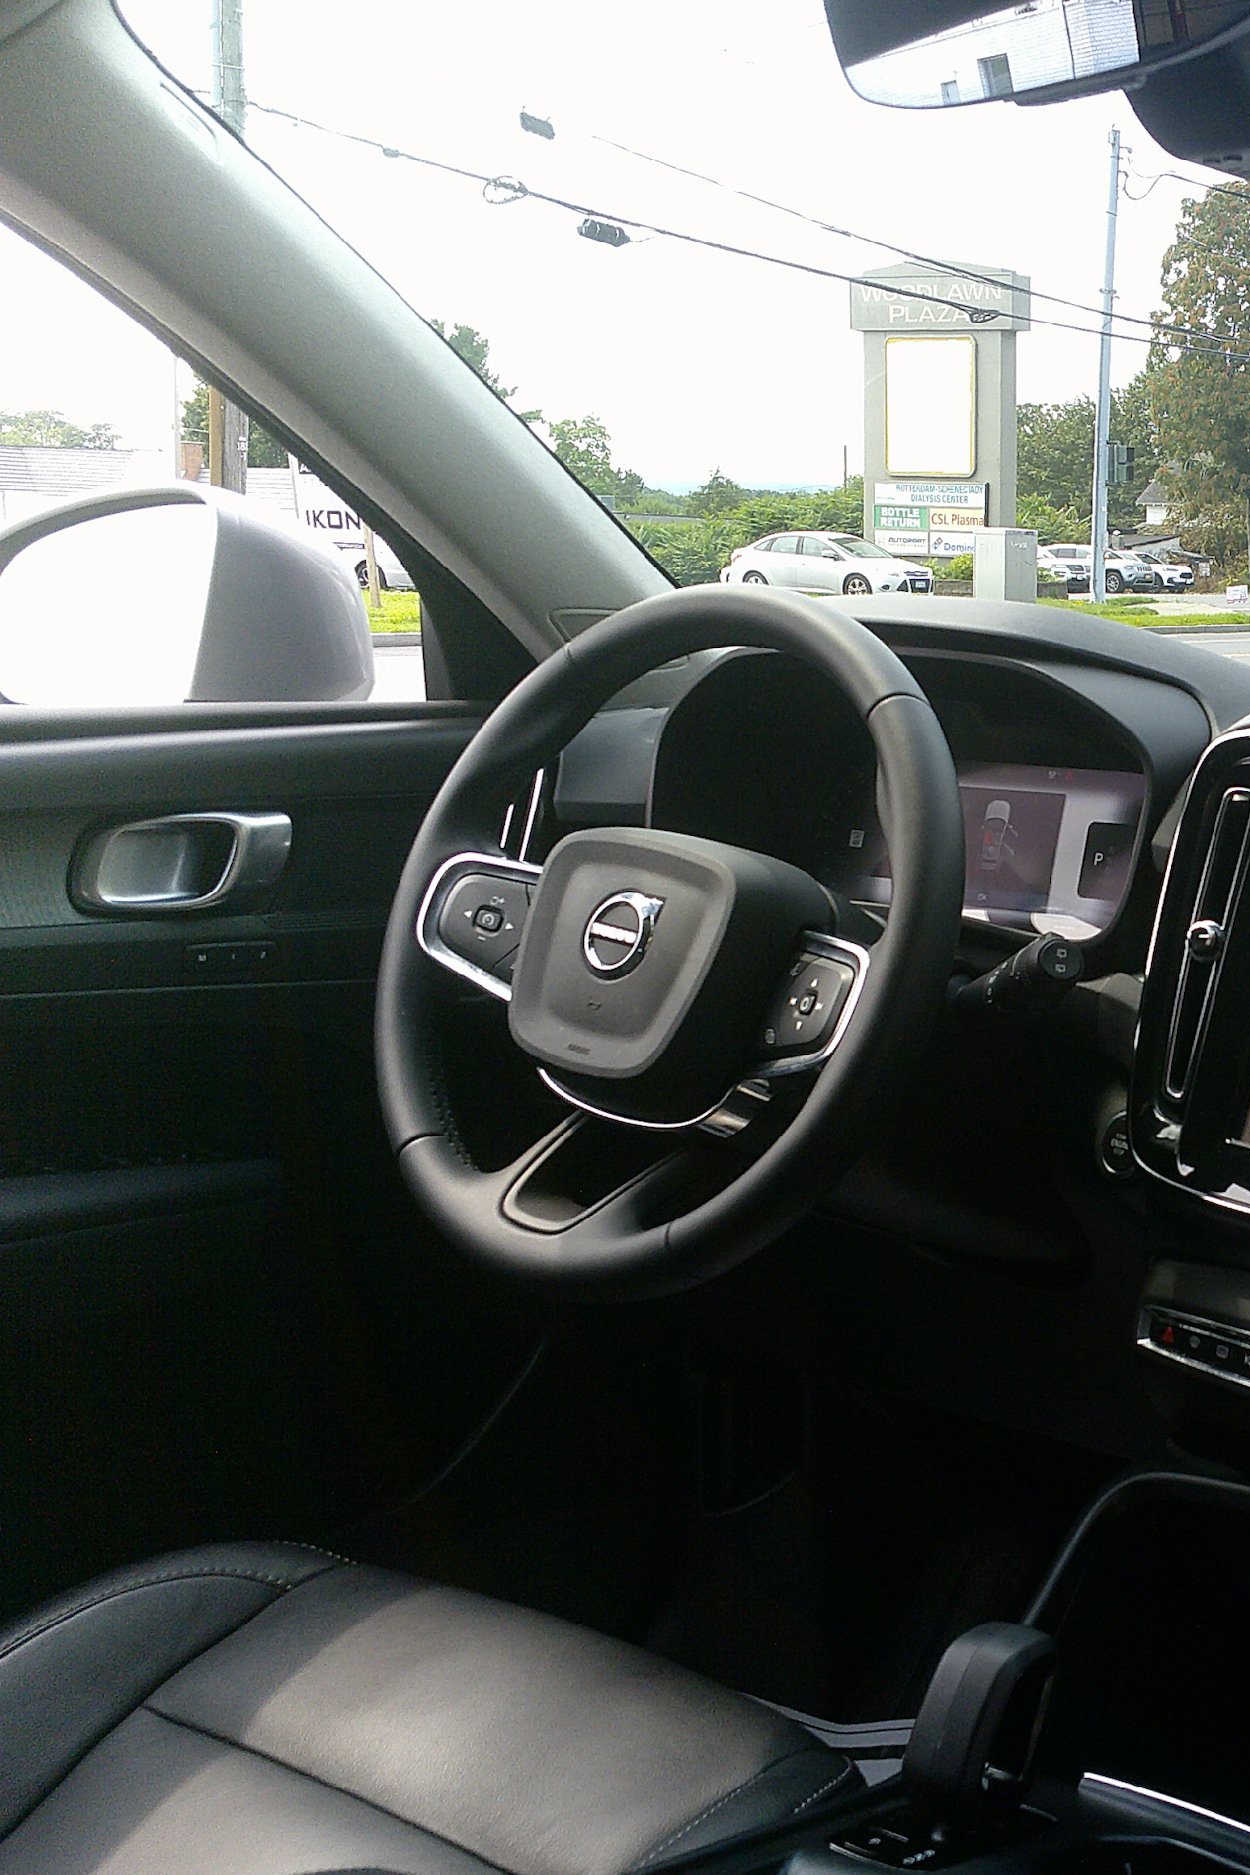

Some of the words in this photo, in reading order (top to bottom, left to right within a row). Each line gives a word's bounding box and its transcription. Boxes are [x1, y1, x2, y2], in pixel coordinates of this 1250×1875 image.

[859, 284, 1001, 302] WOODLAWN
[888, 305, 974, 324] PLAZA
[895, 484, 983, 495] ROTTERDAM-SCHENECTADY
[910, 495, 941, 503] DIALYSIS
[942, 495, 969, 504] CENTER
[880, 506, 920, 517] BOTTLE
[306, 509, 362, 530] IKON
[880, 517, 921, 528] RETURN
[931, 513, 949, 525] CSL
[951, 514, 985, 526] Plasma
[1093, 852, 1104, 866] P
